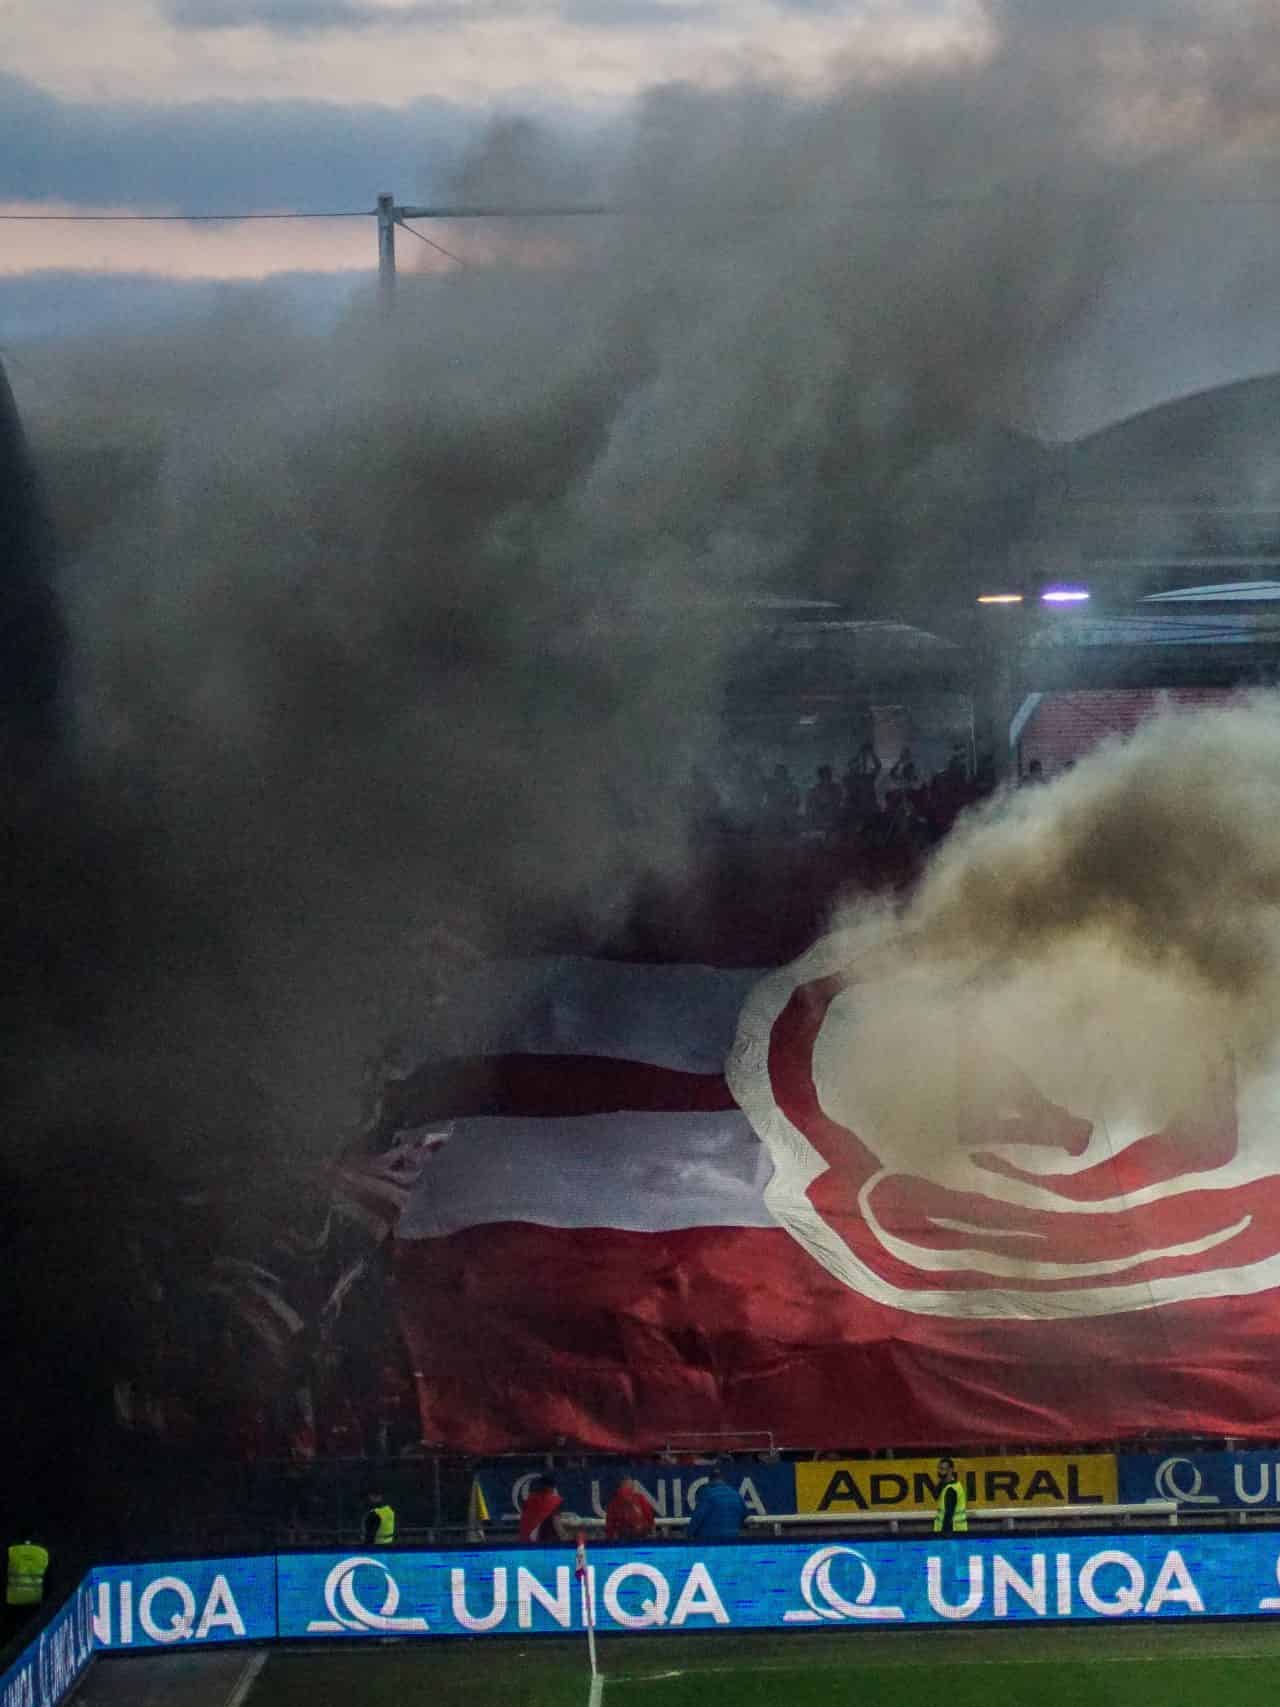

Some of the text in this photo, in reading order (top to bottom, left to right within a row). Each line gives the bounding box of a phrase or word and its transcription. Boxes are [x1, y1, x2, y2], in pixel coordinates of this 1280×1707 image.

[817, 1464, 1104, 1511] ADMIRAL
[451, 1562, 731, 1631] UNIQA
[927, 1549, 1205, 1618] UNIQA
